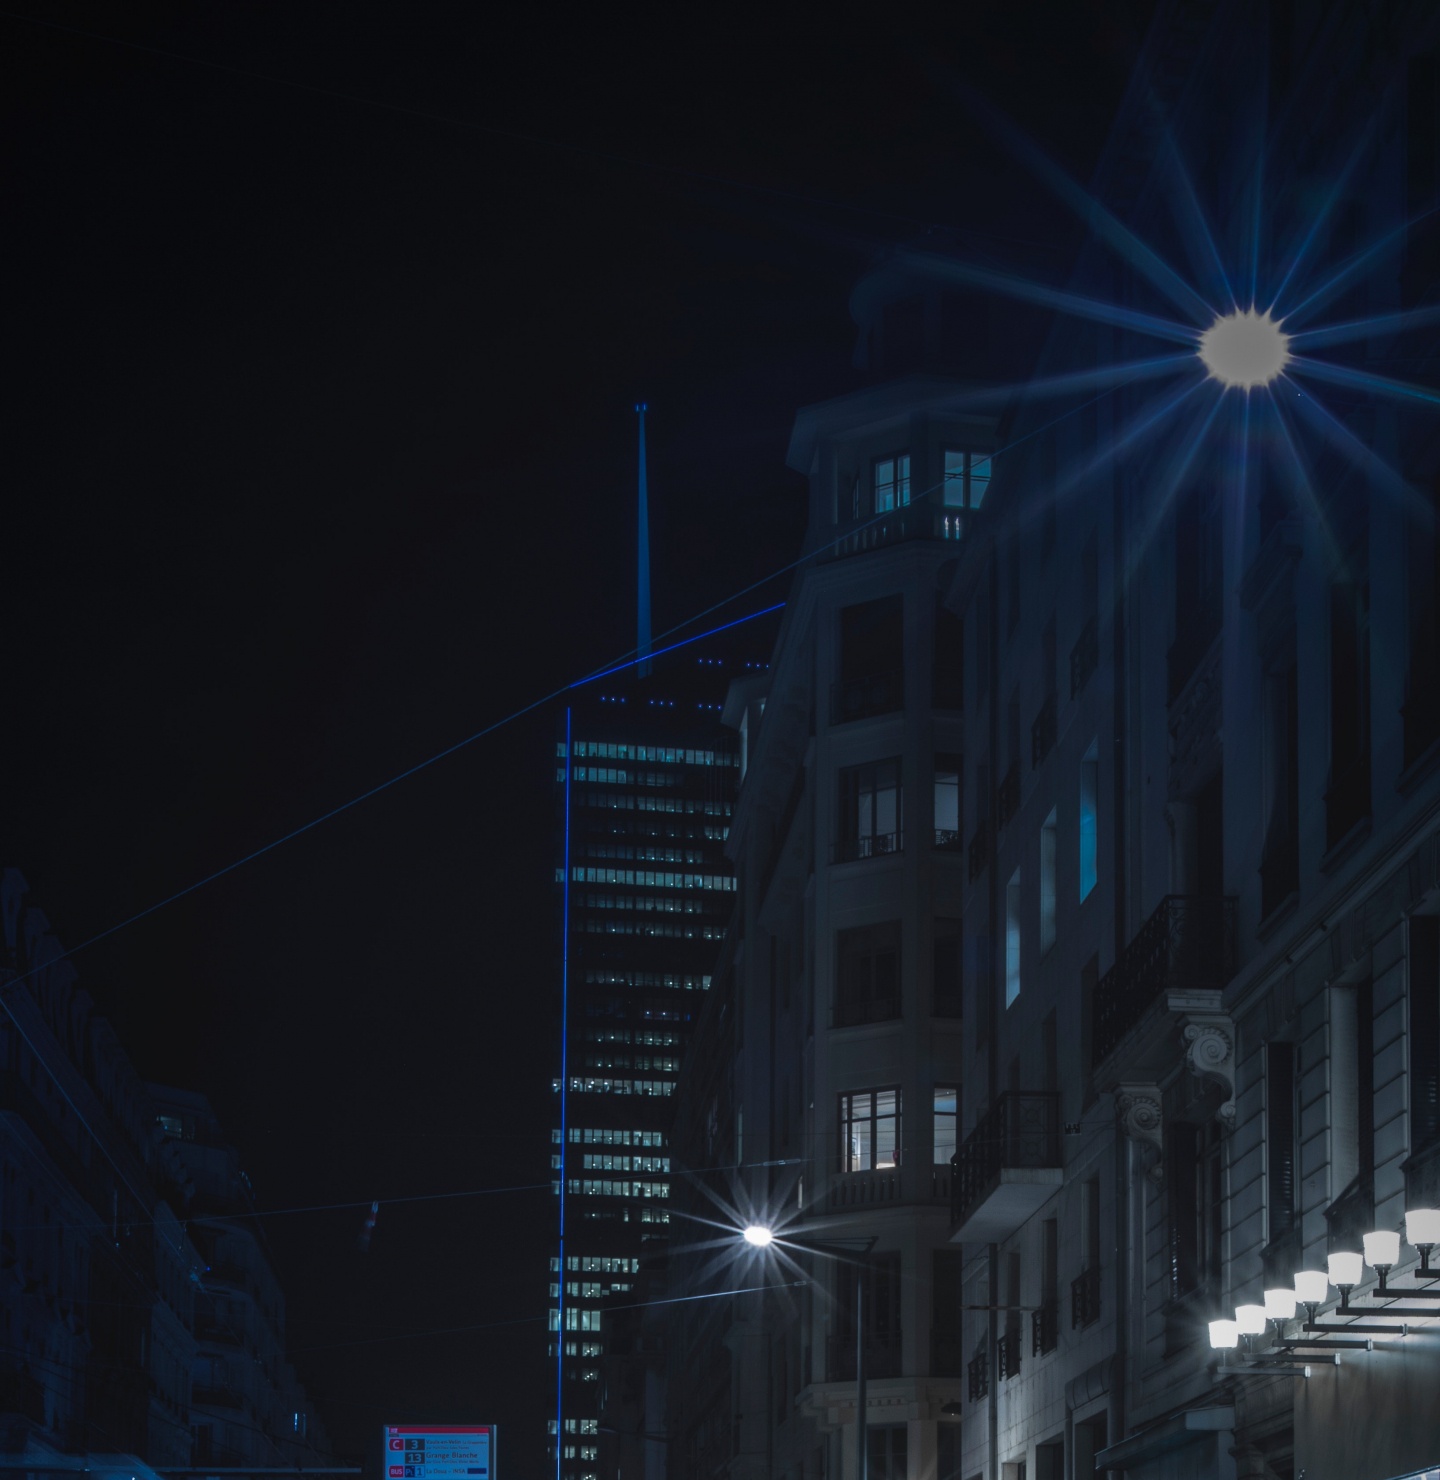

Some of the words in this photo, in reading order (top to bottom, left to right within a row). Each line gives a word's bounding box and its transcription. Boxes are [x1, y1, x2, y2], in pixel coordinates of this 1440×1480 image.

[392, 1440, 400, 1450] C
[411, 1440, 419, 1450] 3
[407, 1453, 422, 1463] 13
[426, 1452, 450, 1460] Grange
[451, 1451, 478, 1459] Blanche
[416, 1468, 422, 1476] 1
